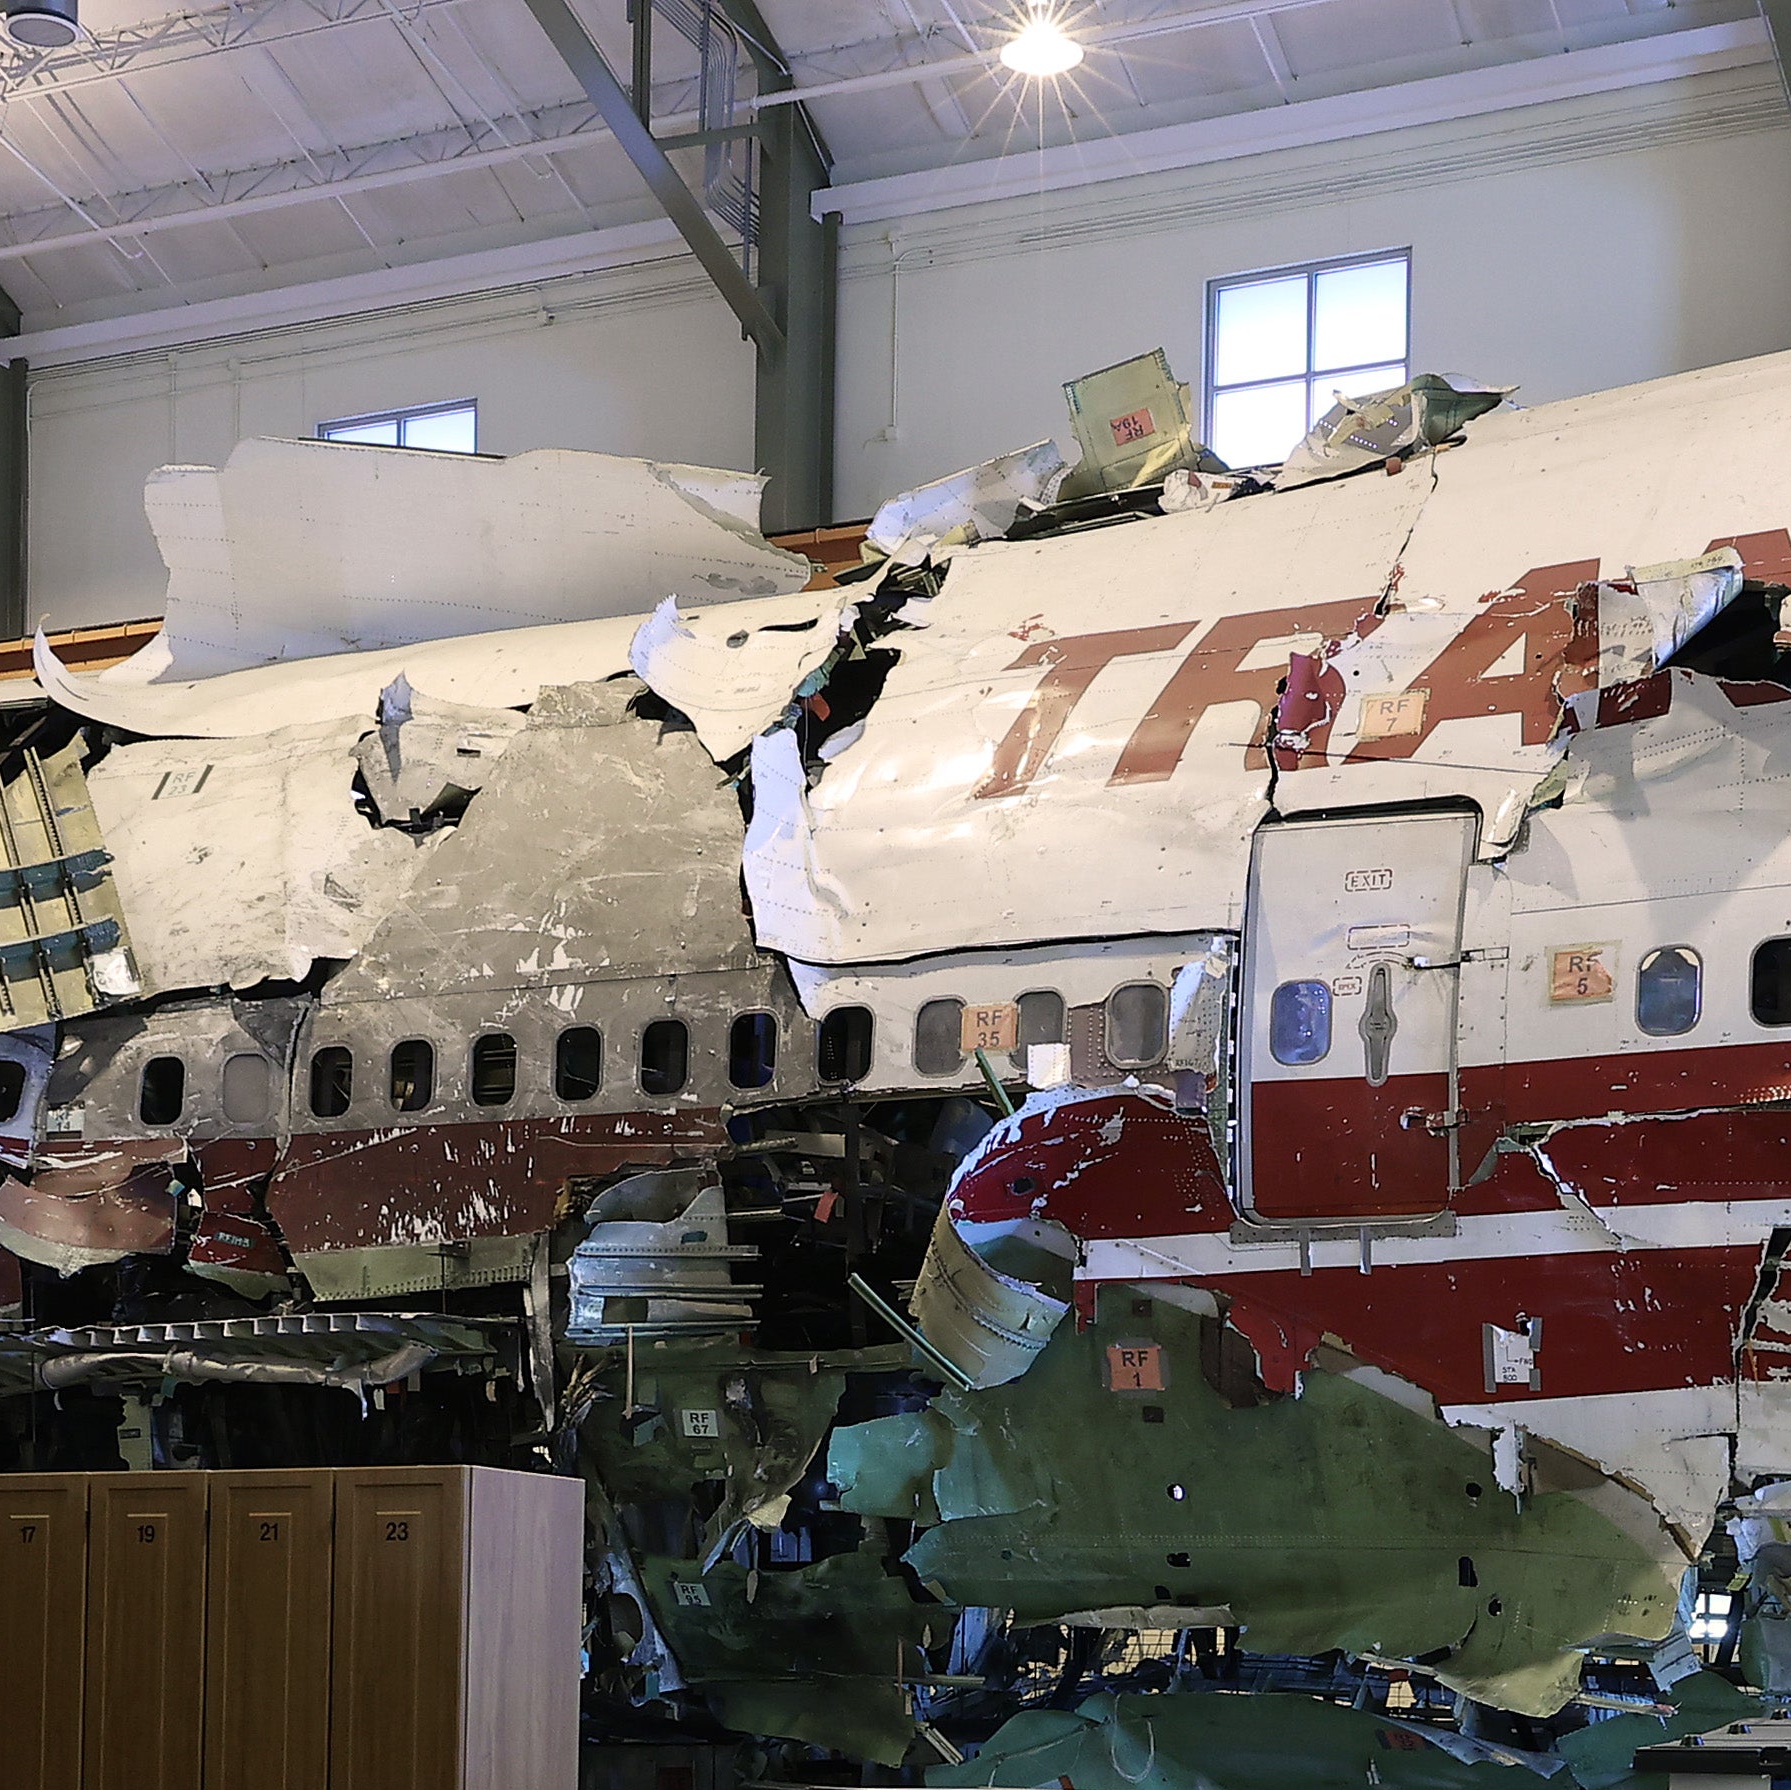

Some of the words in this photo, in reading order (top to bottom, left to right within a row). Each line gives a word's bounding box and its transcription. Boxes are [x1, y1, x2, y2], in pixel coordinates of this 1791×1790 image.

[1380, 699, 1409, 715] RF
[1386, 717, 1398, 733] 7
[172, 771, 197, 784] RF
[1350, 874, 1386, 887] EXIT
[1569, 956, 1600, 972] RF
[1577, 978, 1588, 995] 5
[976, 1010, 1002, 1027] RF
[977, 1031, 1000, 1047] 35
[57, 1122, 71, 1132] 14
[1121, 1351, 1148, 1367] RF
[1133, 1372, 1141, 1387] 1
[689, 1413, 709, 1423] RF
[693, 1424, 709, 1435] 67
[20, 1526, 36, 1544] 17
[137, 1525, 155, 1543] 19
[260, 1523, 278, 1541] 21
[386, 1522, 409, 1541] 23
[681, 1585, 697, 1594] RF
